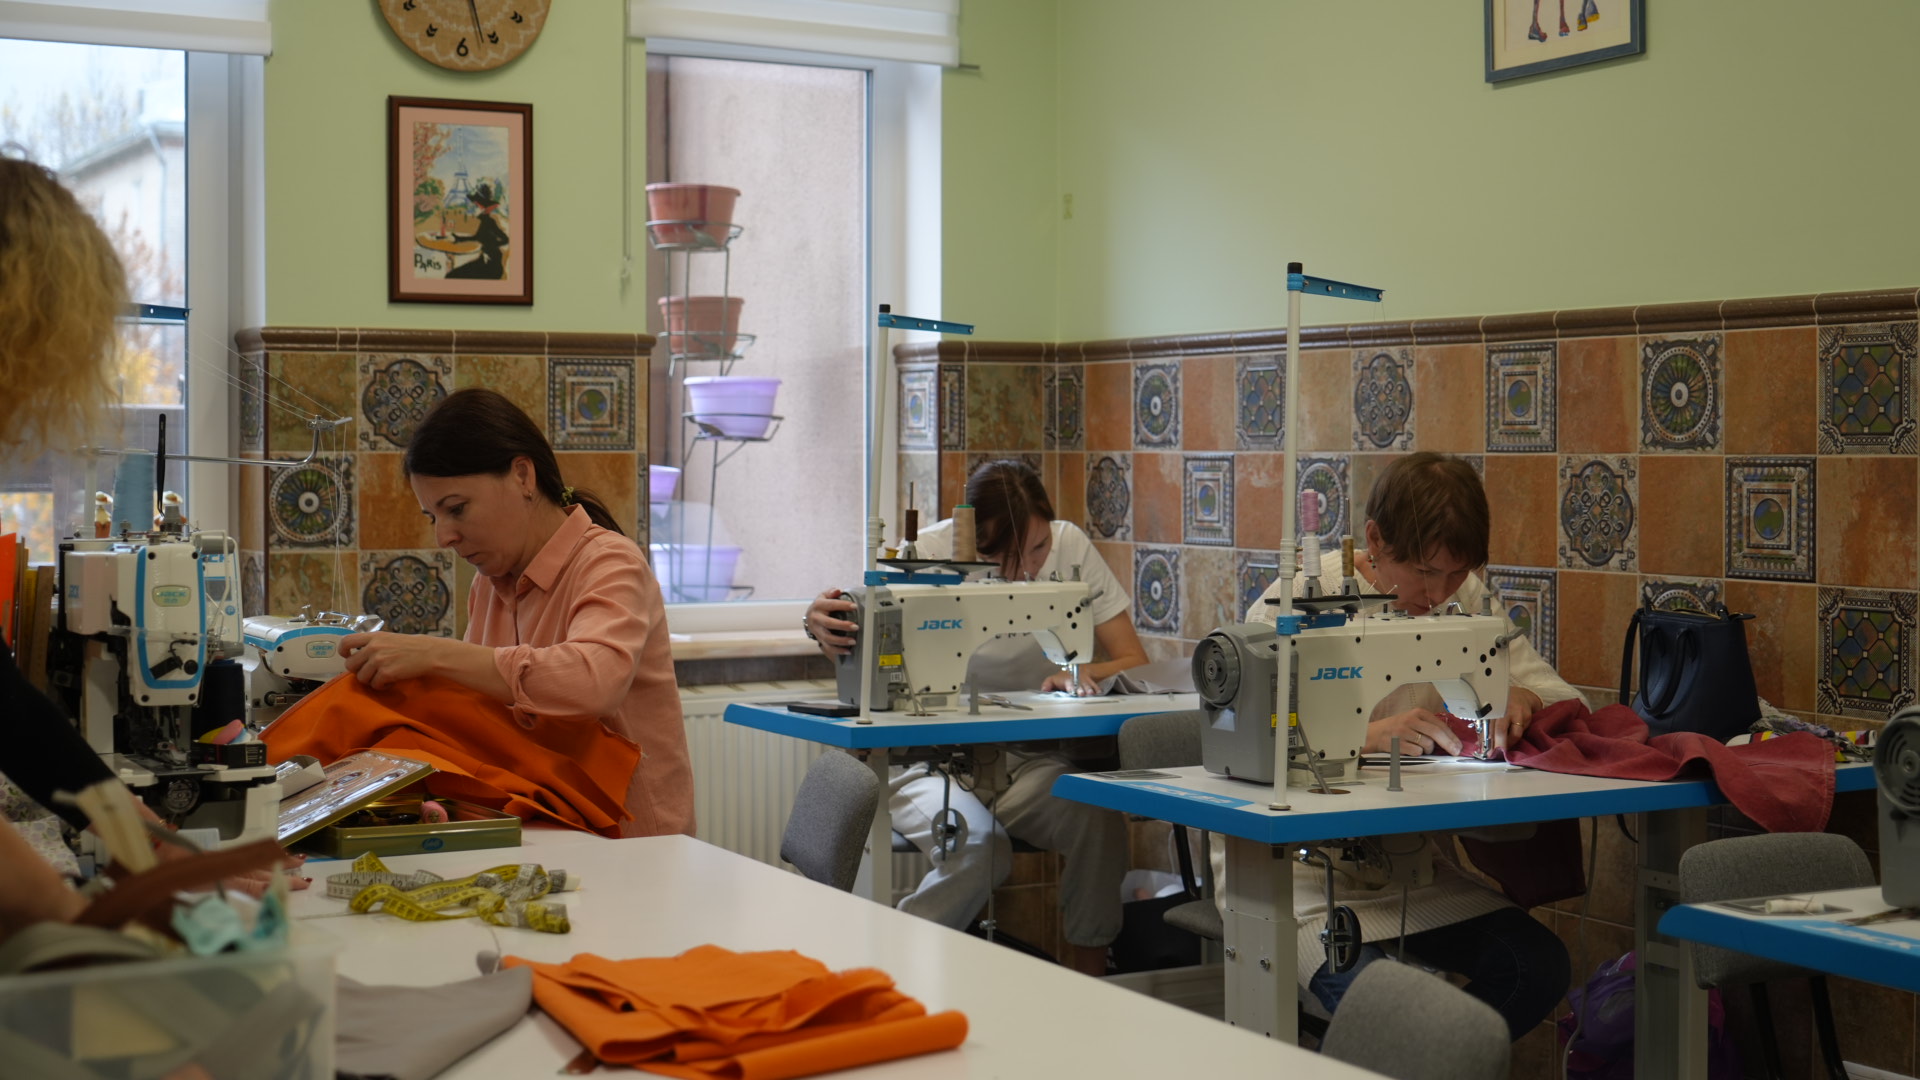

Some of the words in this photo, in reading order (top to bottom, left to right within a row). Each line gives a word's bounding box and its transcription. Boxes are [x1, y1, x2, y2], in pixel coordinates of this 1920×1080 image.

[456, 37, 469, 57] 6
[917, 619, 963, 631] JACK
[1310, 666, 1364, 681] JACK
